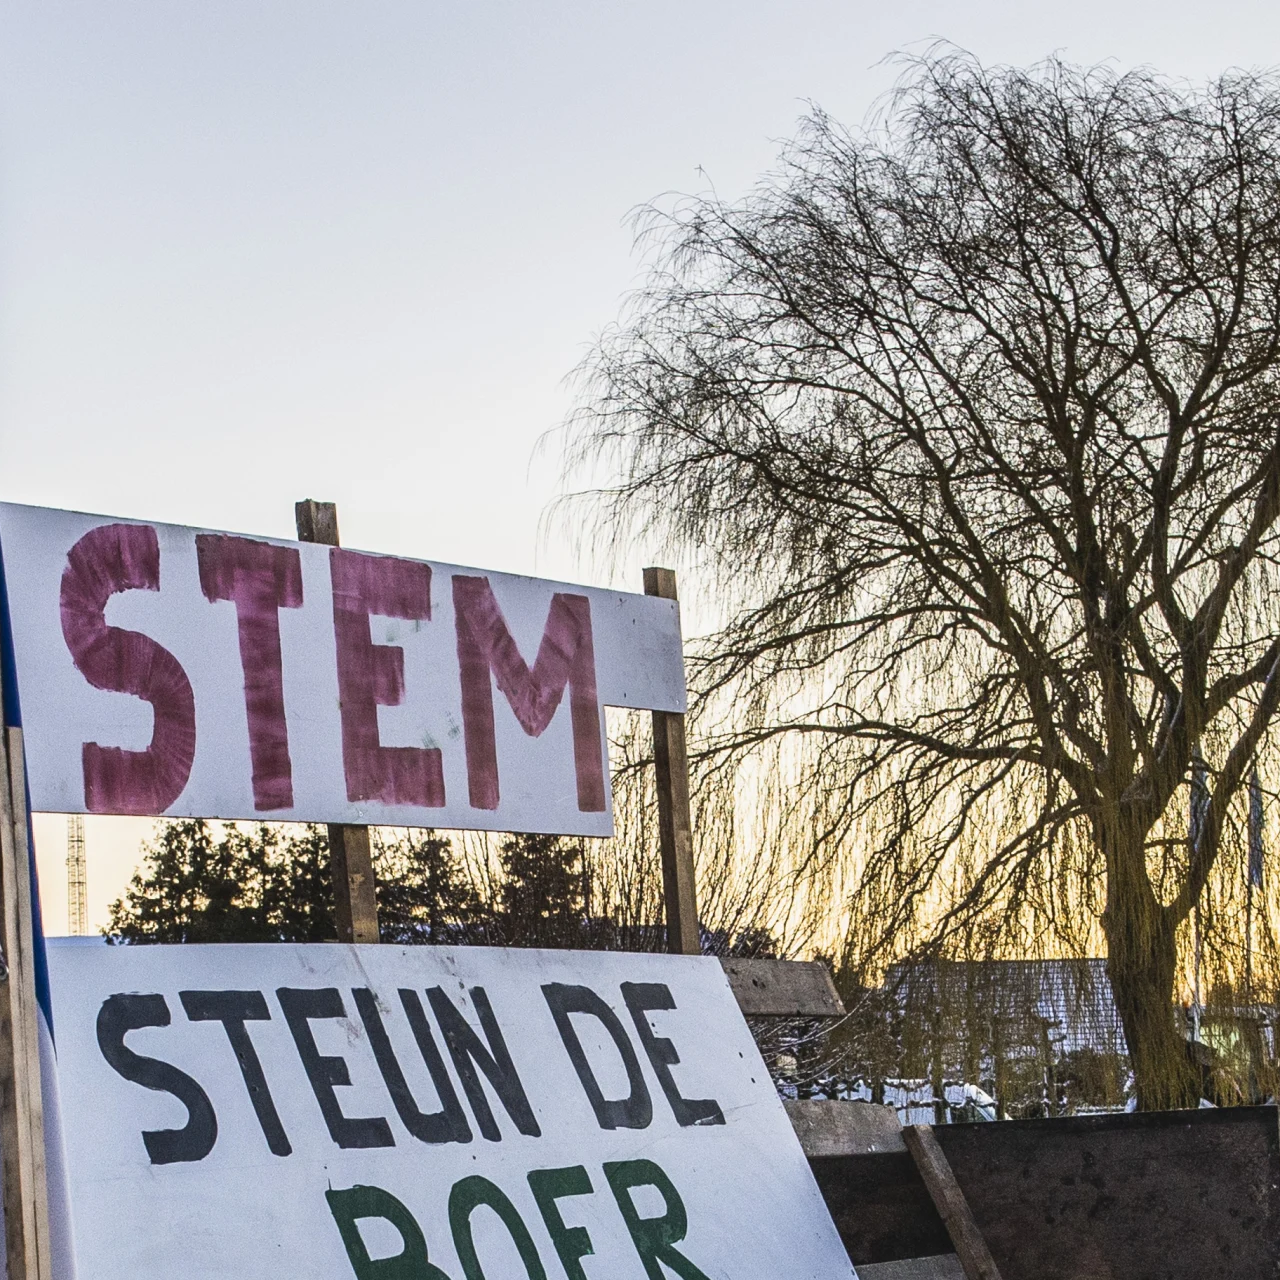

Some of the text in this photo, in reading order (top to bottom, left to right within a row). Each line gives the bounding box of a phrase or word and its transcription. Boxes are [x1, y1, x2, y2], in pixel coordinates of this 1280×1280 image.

[60, 523, 606, 814] STEM
[96, 981, 726, 1165] STEUN DE
